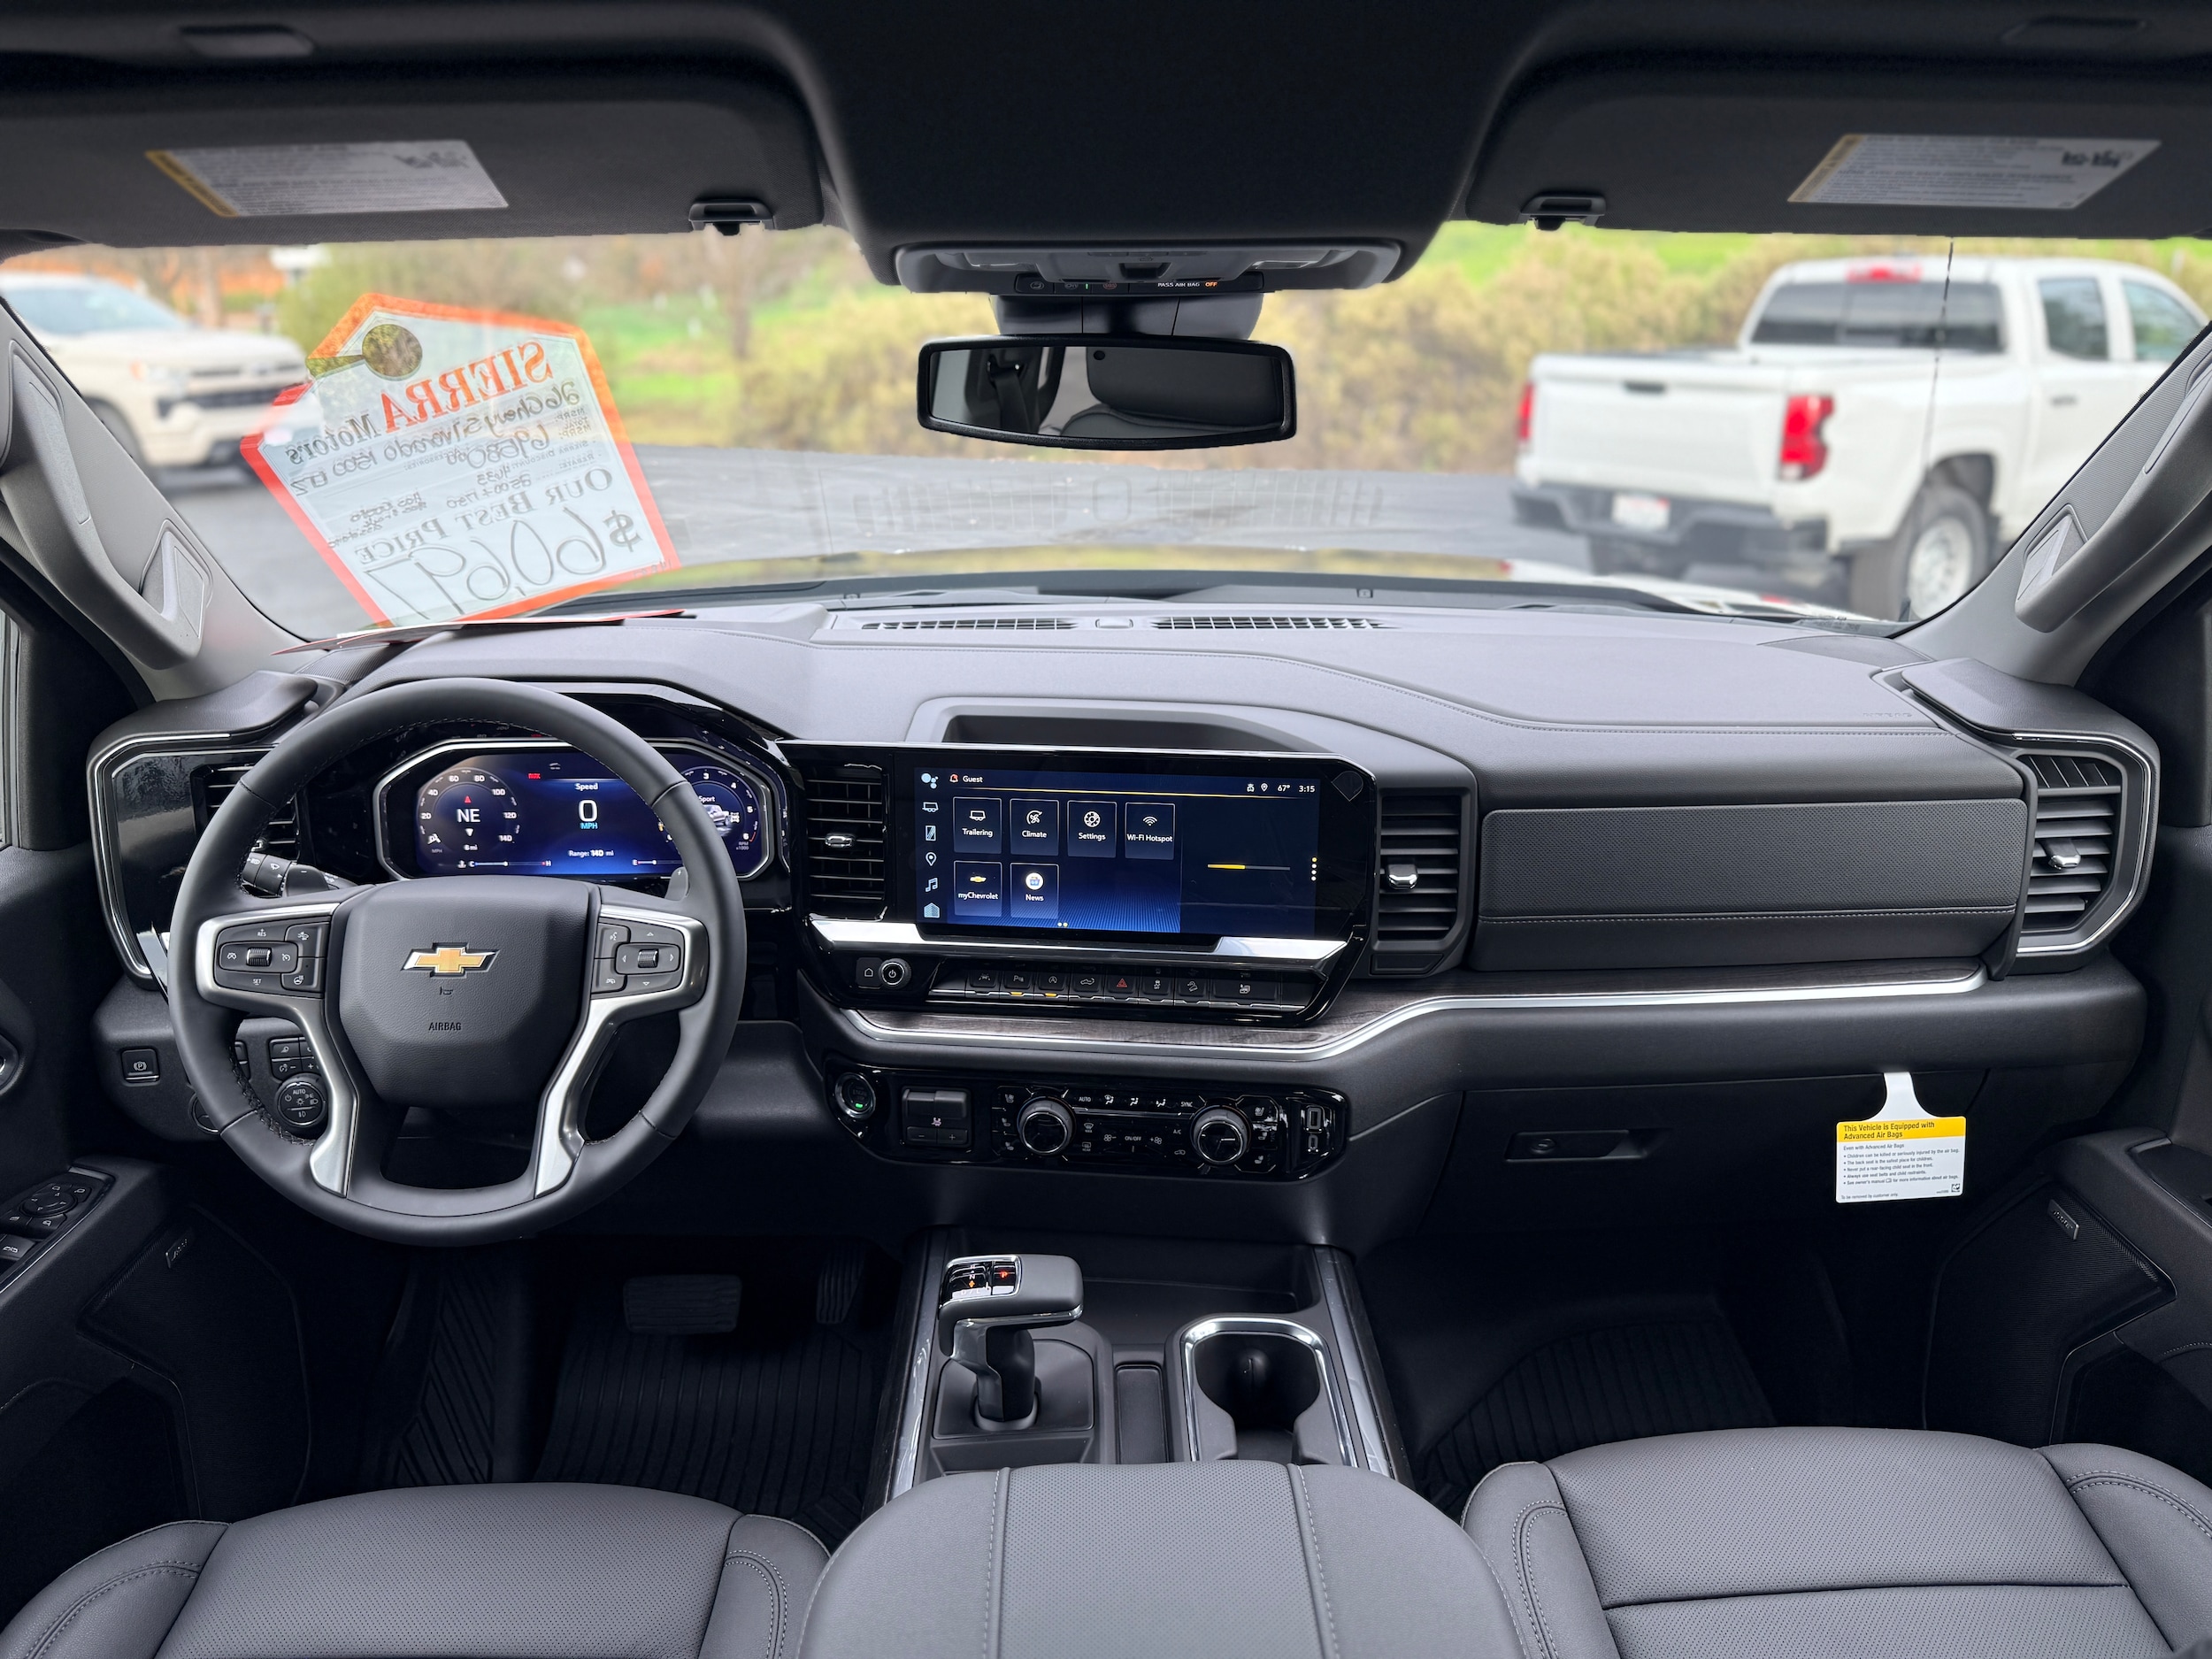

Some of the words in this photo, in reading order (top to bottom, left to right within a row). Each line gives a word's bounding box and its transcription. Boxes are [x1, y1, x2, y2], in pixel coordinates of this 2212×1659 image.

[575, 782, 599, 791] Speed
[1298, 785, 1316, 793] 3:15
[578, 799, 598, 822] 0
[457, 808, 481, 823] NE
[962, 828, 993, 838] Trailering
[1022, 830, 1047, 839] Climate
[1078, 831, 1106, 841] Settings
[1145, 834, 1173, 843] Hotspot
[568, 849, 590, 858] Range:
[958, 891, 999, 901] myChevrolet
[428, 1022, 462, 1031] AIRBAG
[1890, 1122, 1920, 1131] Equipped
